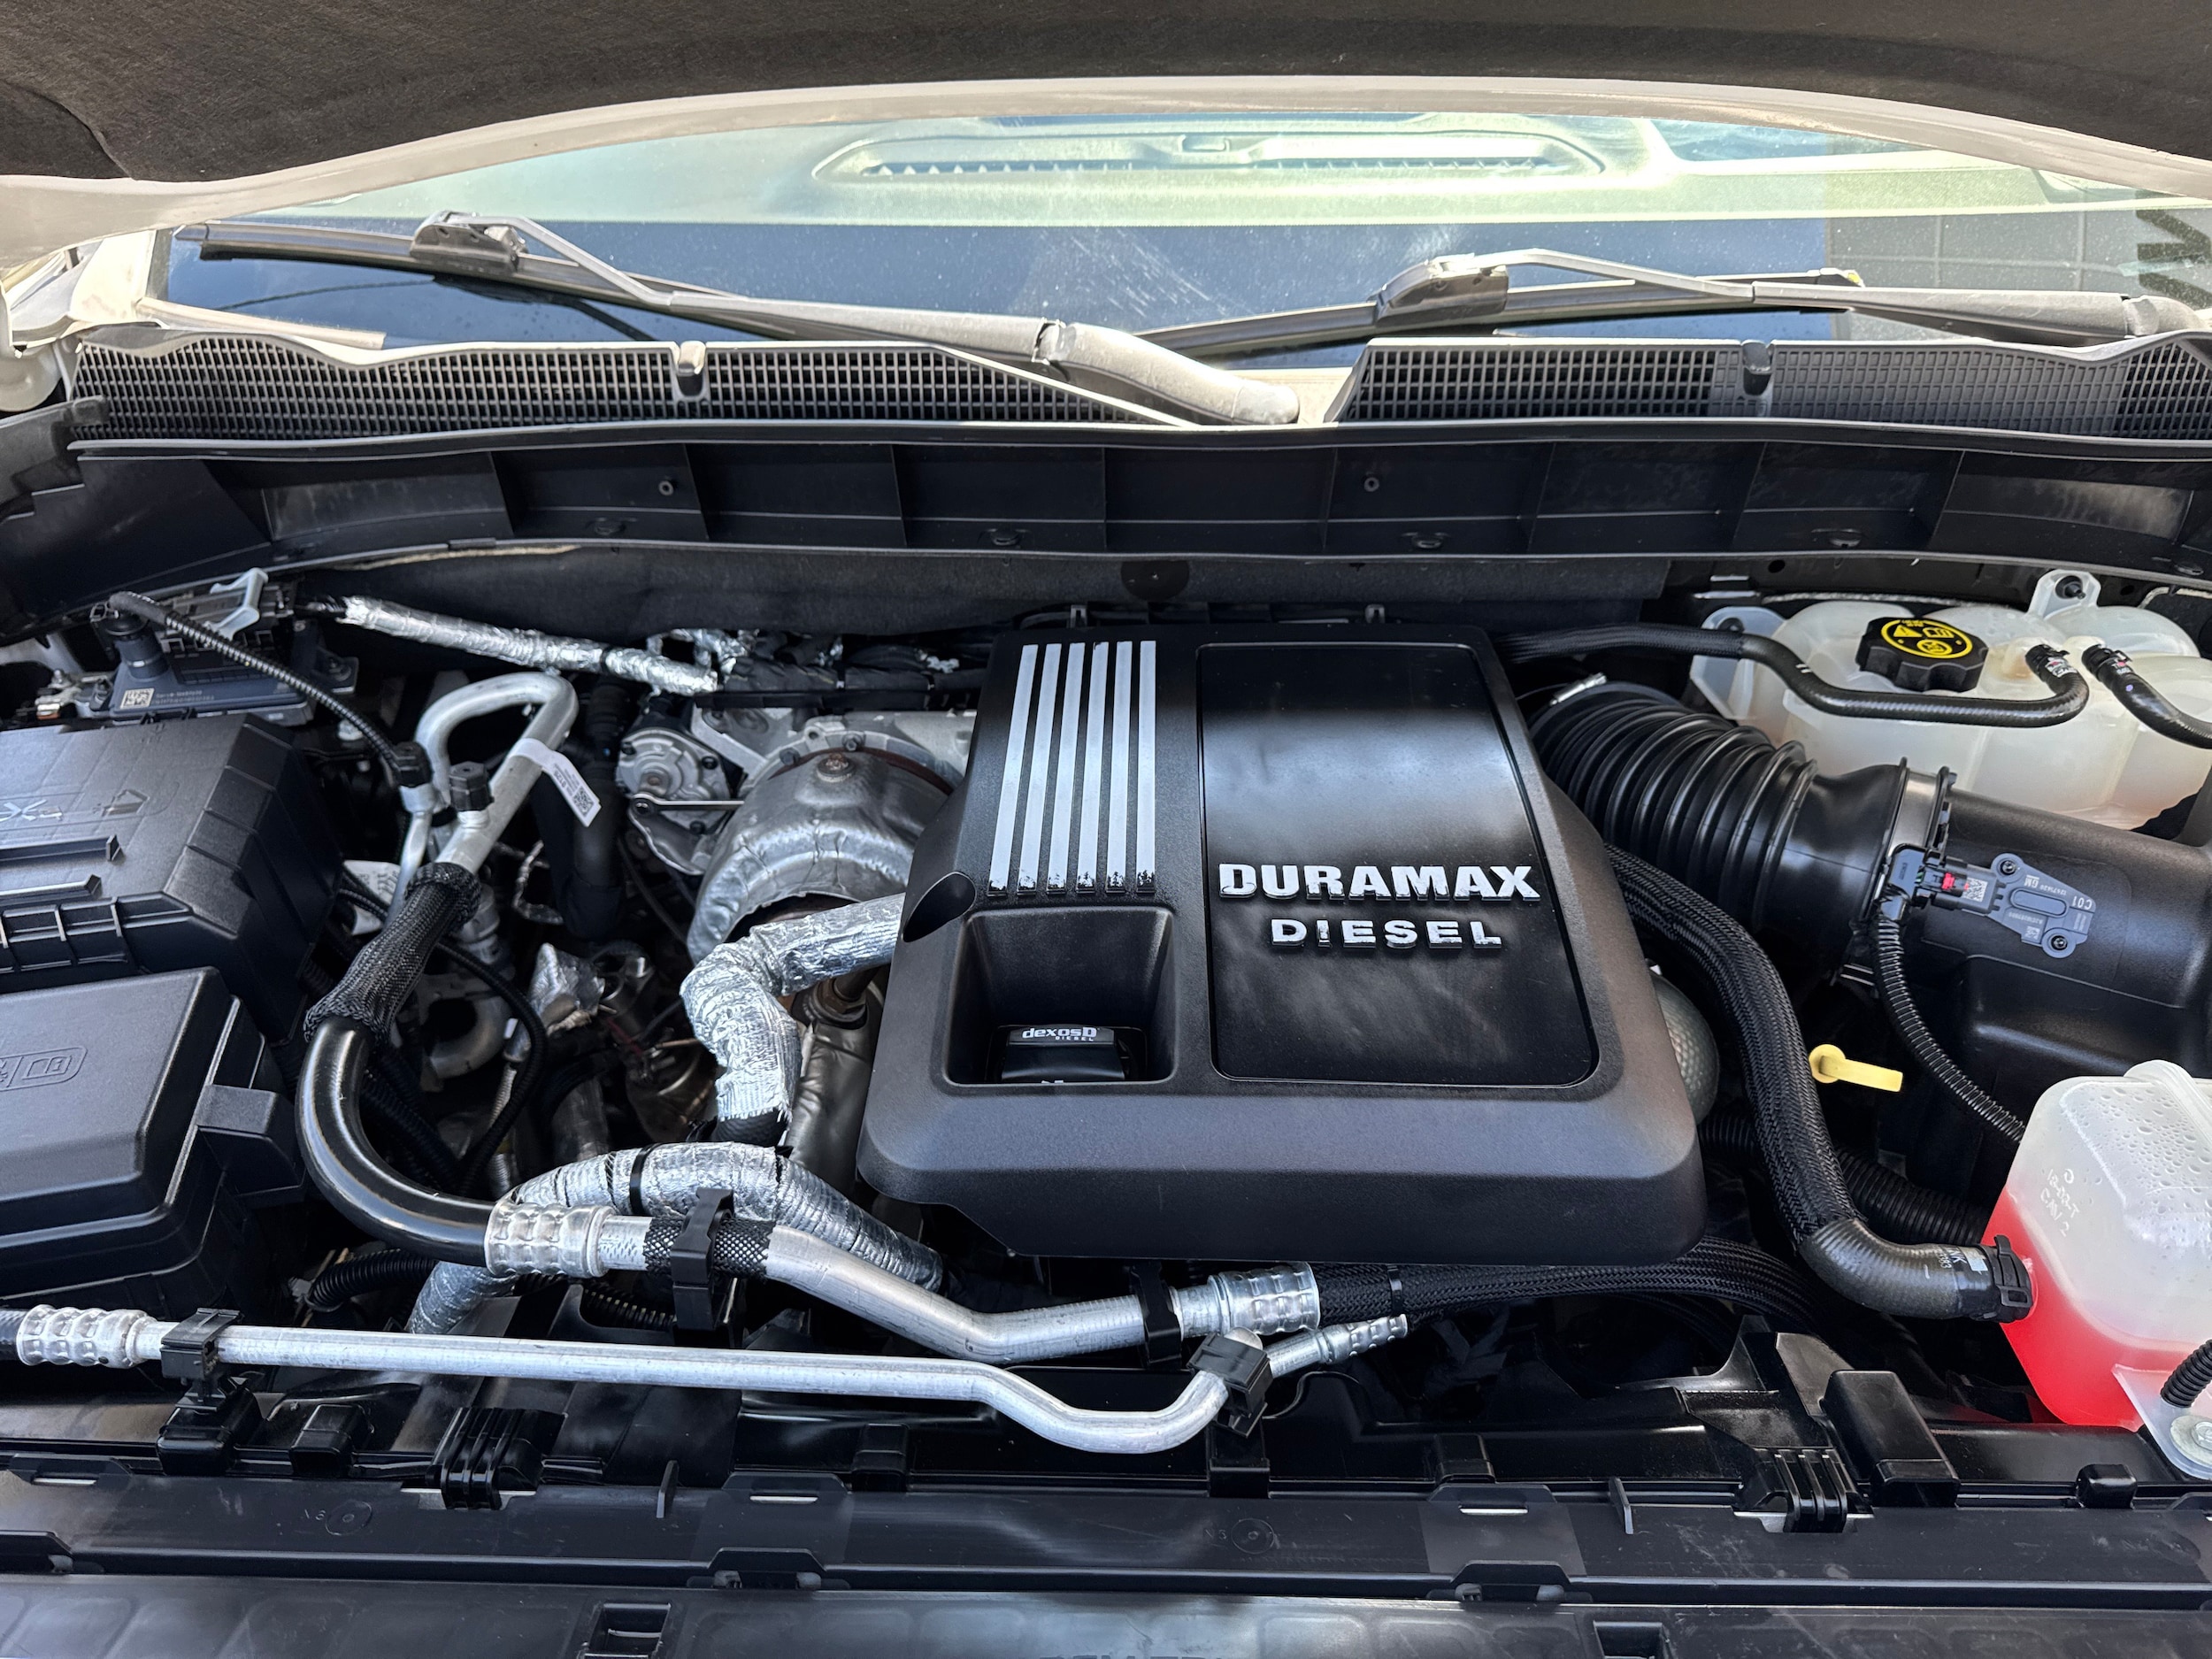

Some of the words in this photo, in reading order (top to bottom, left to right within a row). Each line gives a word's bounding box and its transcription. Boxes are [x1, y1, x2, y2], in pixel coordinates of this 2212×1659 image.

[1219, 864, 1540, 901] DURAMAX
[2024, 874, 2039, 888] GM
[1271, 919, 1502, 949] DIESEL
